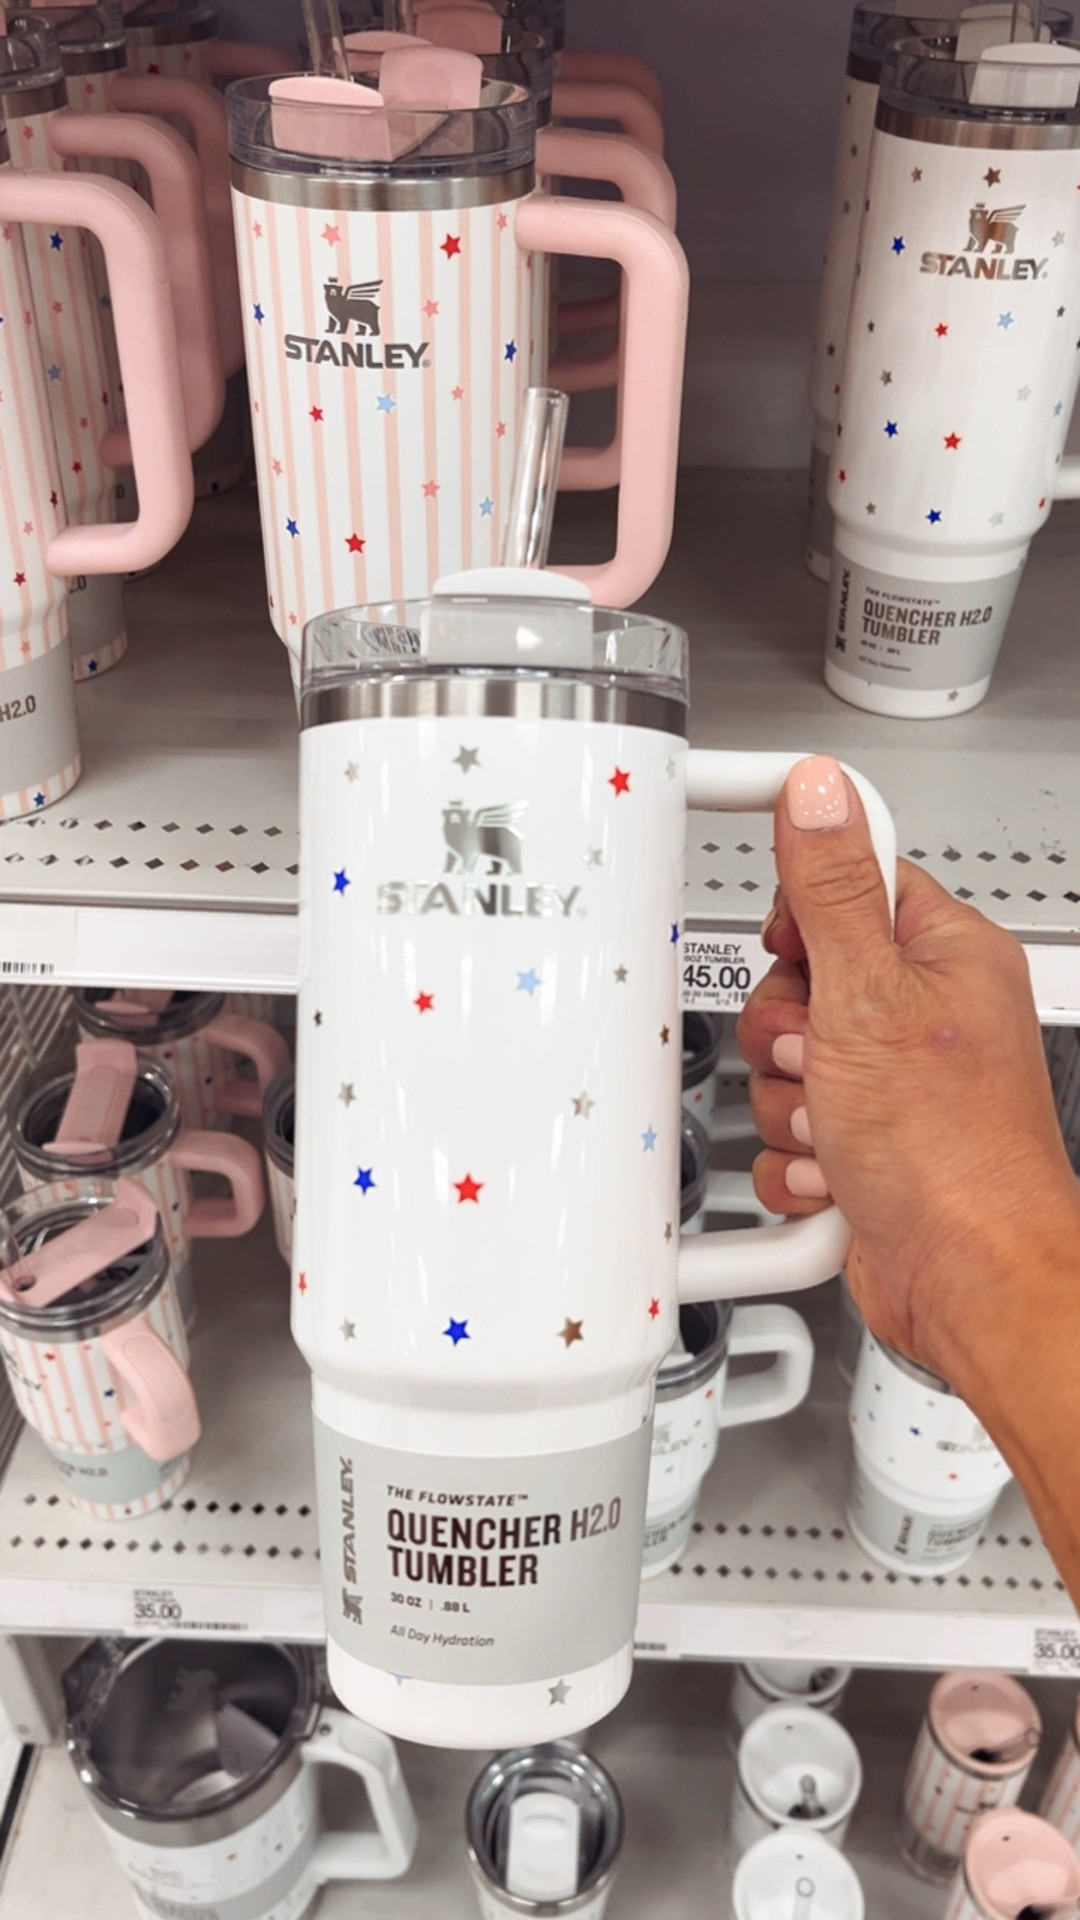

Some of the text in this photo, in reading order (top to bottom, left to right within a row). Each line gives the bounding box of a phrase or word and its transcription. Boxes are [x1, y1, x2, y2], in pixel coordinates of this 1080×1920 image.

[920, 251, 1049, 281] STANLEY
[863, 598, 993, 628] QUENCHER H2.0
[862, 616, 941, 646] TUMBLER
[377, 881, 581, 917] STANLEY
[683, 942, 742, 955] STANLEY
[704, 956, 745, 964] TUMBLER
[683, 964, 751, 989] 45.00
[387, 1484, 414, 1501] THE
[339, 1455, 358, 1585] STANLEY
[386, 1507, 562, 1551] QUENCHER
[569, 1495, 622, 1542] H2.0
[387, 1544, 539, 1588] TUMBLER
[134, 1602, 182, 1620] 35.00
[390, 1591, 404, 1604] 30
[406, 1595, 422, 1608] OZ
[441, 1601, 460, 1613] .88
[462, 1602, 470, 1613] L
[390, 1624, 495, 1648] All Day Hydration
